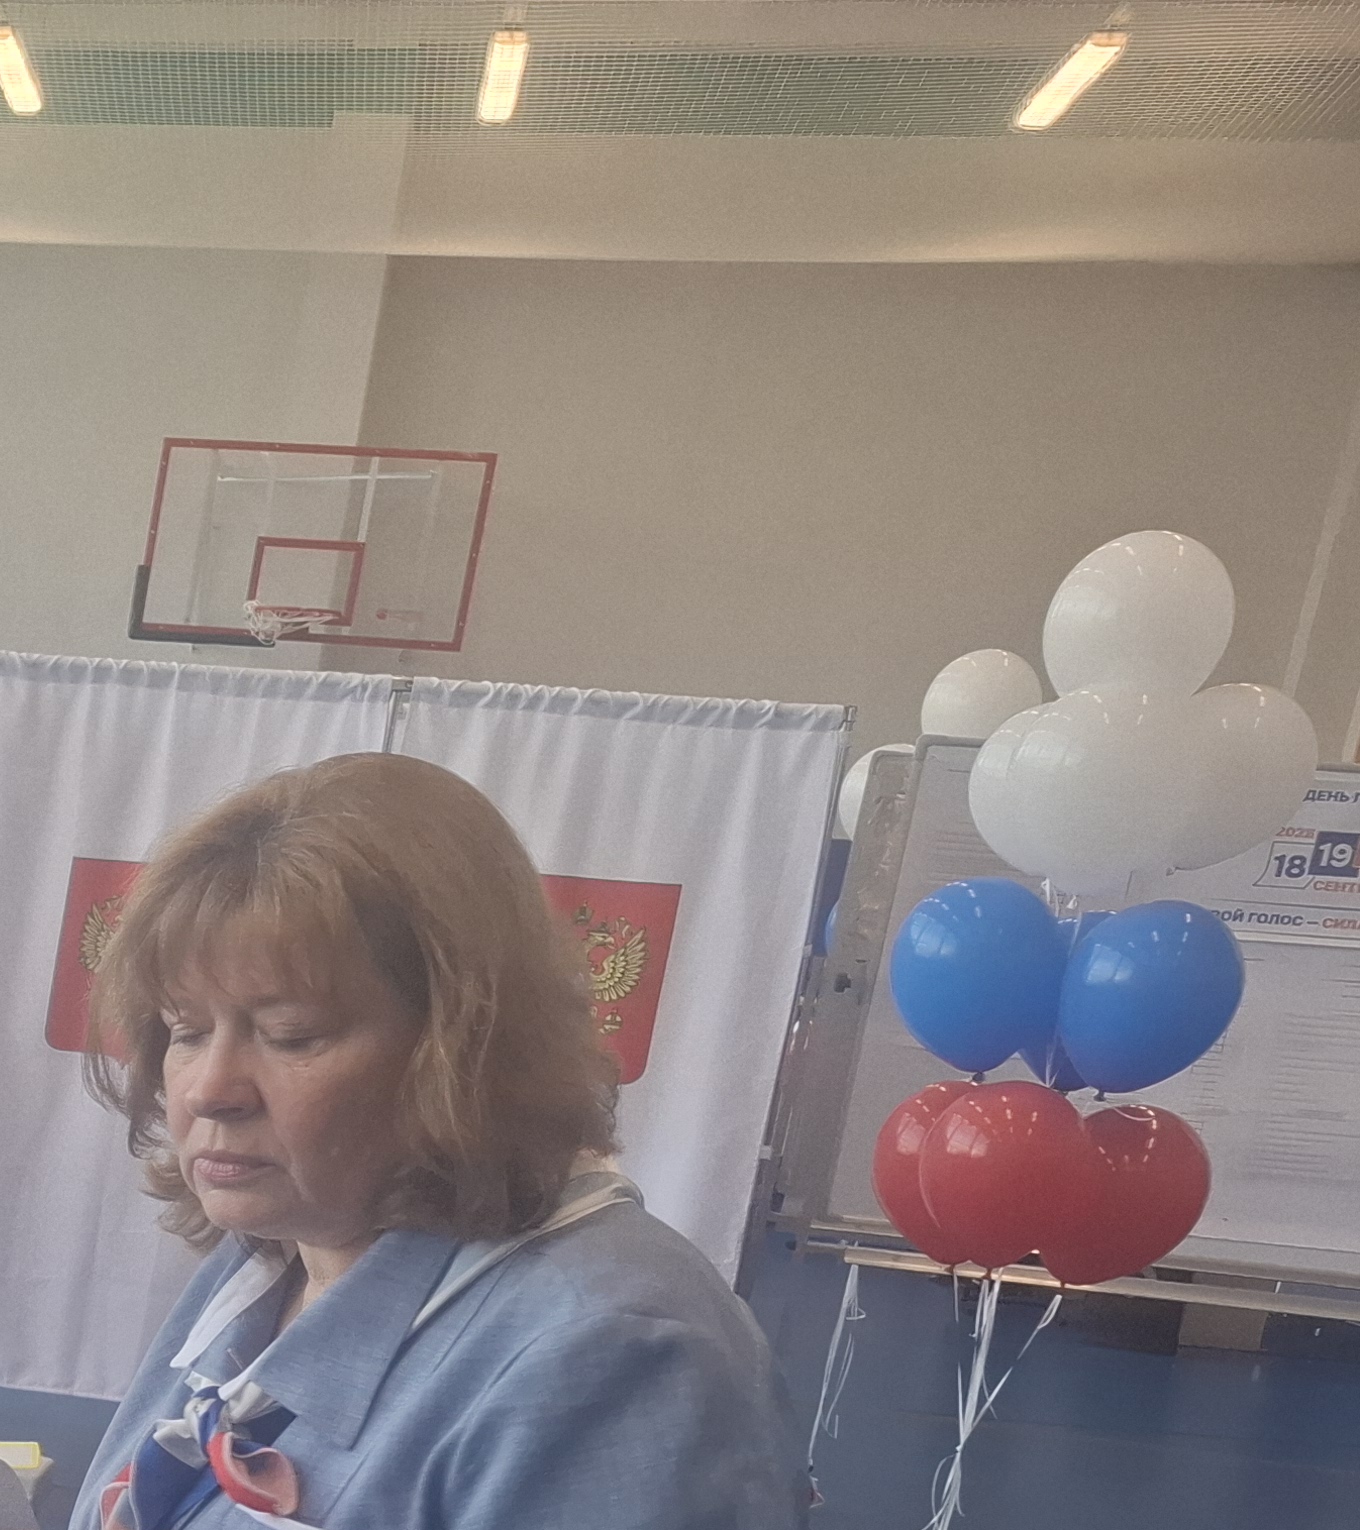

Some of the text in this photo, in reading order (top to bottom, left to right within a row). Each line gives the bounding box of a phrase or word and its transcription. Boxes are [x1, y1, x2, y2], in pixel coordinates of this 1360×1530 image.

[1302, 789, 1350, 803] ДЕНЬ
[1318, 843, 1353, 868] 19
[1273, 854, 1308, 878] 18
[1247, 912, 1304, 927] ГОЛОС
